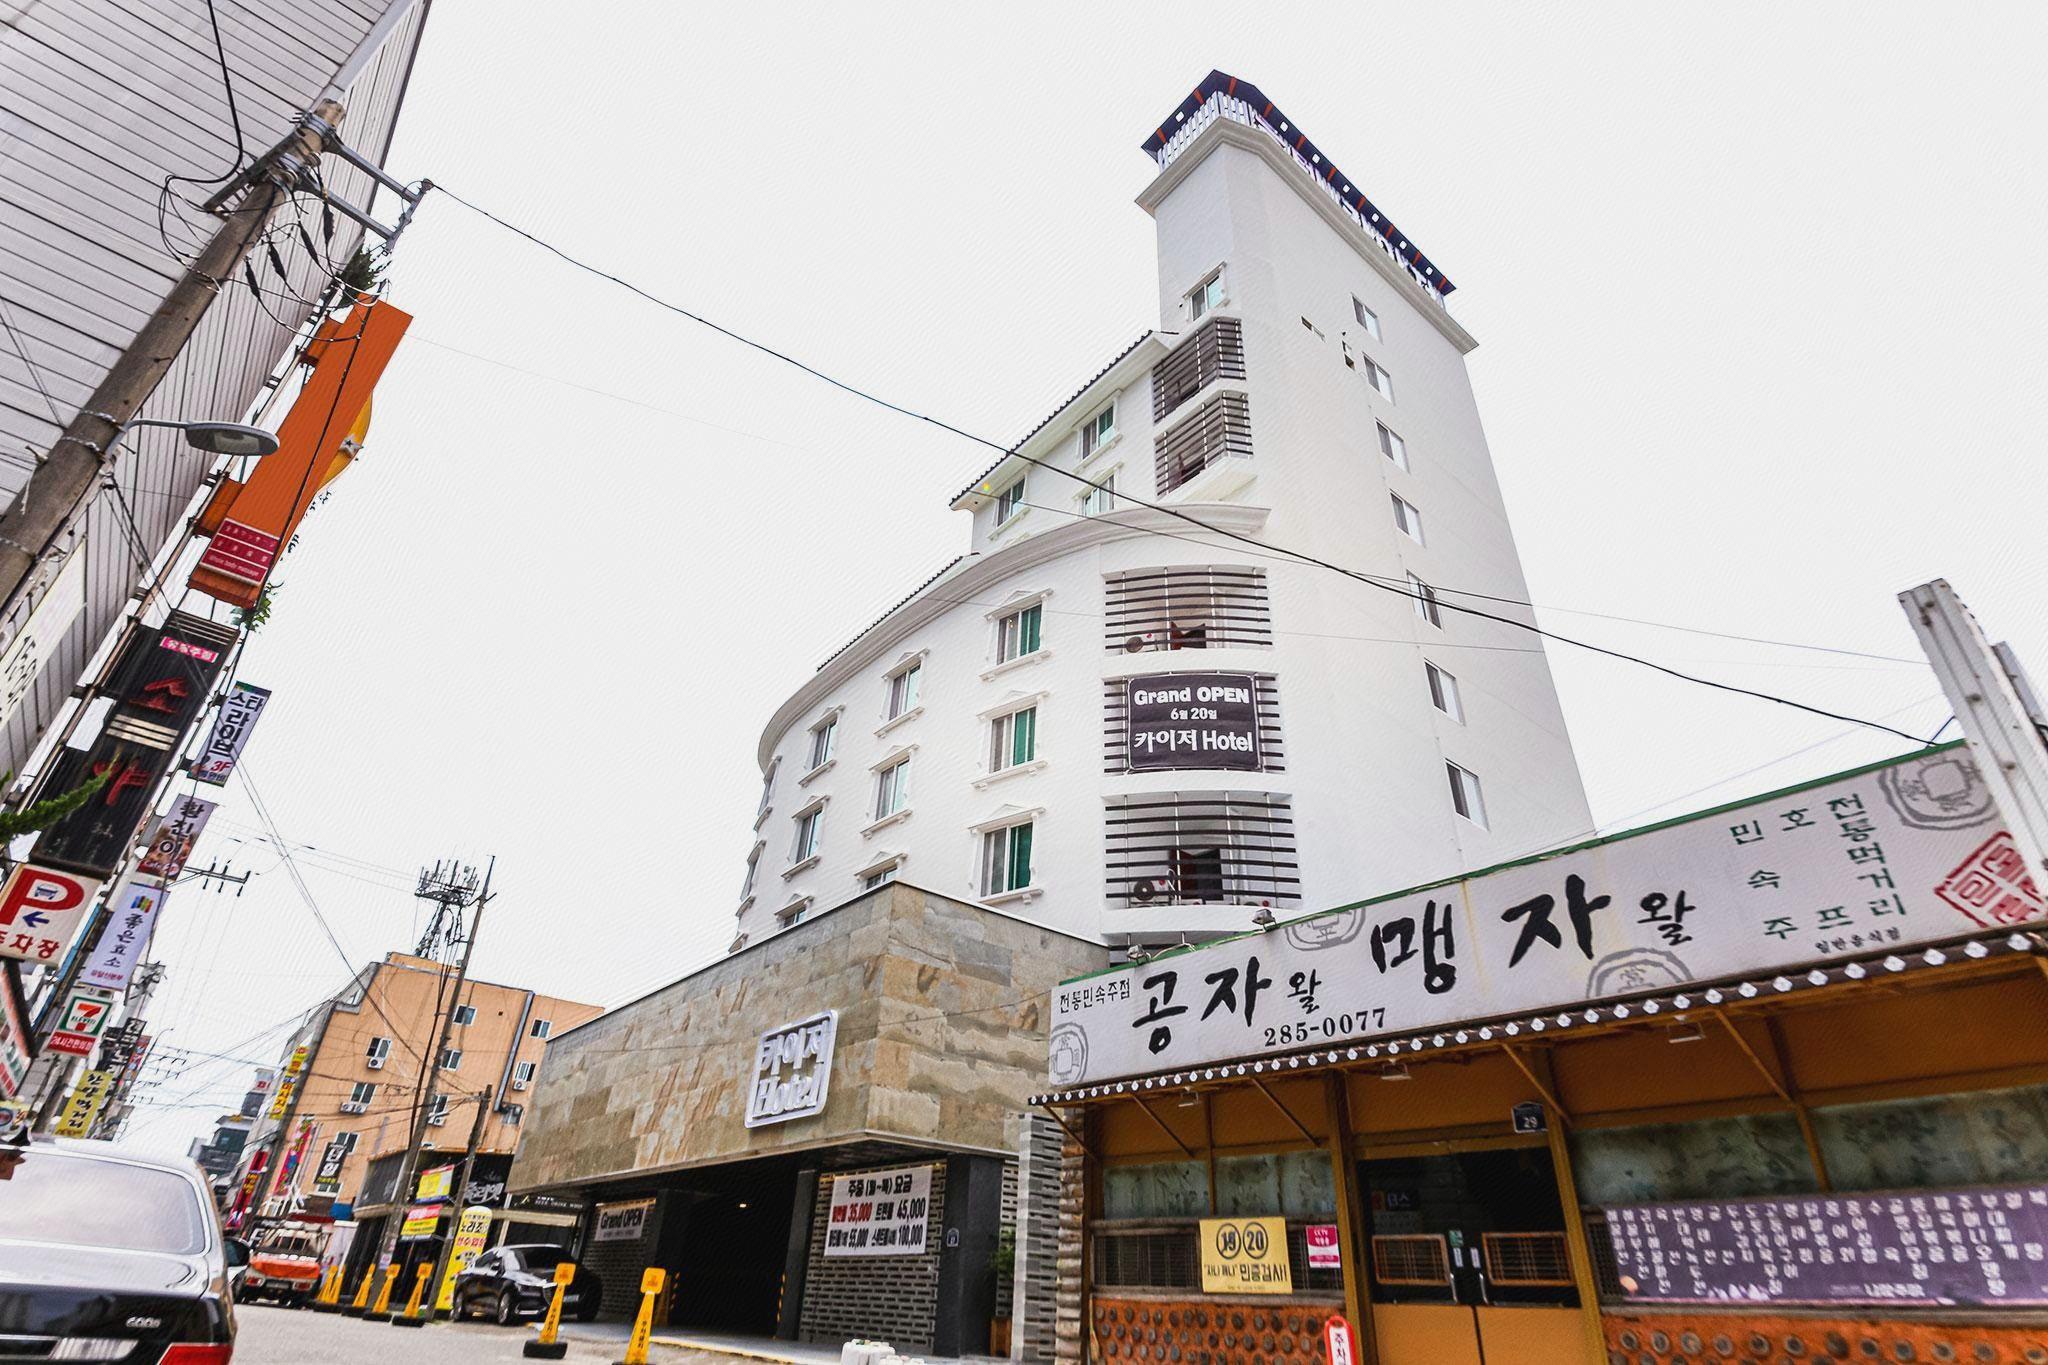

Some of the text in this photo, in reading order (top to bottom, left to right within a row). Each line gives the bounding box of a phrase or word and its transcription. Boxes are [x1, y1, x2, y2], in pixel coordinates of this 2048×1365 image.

[1134, 686, 1250, 706] Grand OPEN
[1170, 707, 1218, 720] 6월 20일
[1134, 729, 1254, 753] 카이저 Hotel
[211, 760, 234, 773] 3F
[0, 868, 84, 926] P
[1060, 978, 1130, 1013] 전통민속주점
[77, 1003, 102, 1032] 7
[1264, 1007, 1387, 1048] 285-0077
[753, 1066, 822, 1118] Hotel
[893, 1174, 913, 1194] 요금
[600, 1210, 623, 1230] Grand
[847, 1202, 873, 1226] 35,000
[896, 1197, 926, 1223] 45,000
[898, 1224, 924, 1249] 100,000
